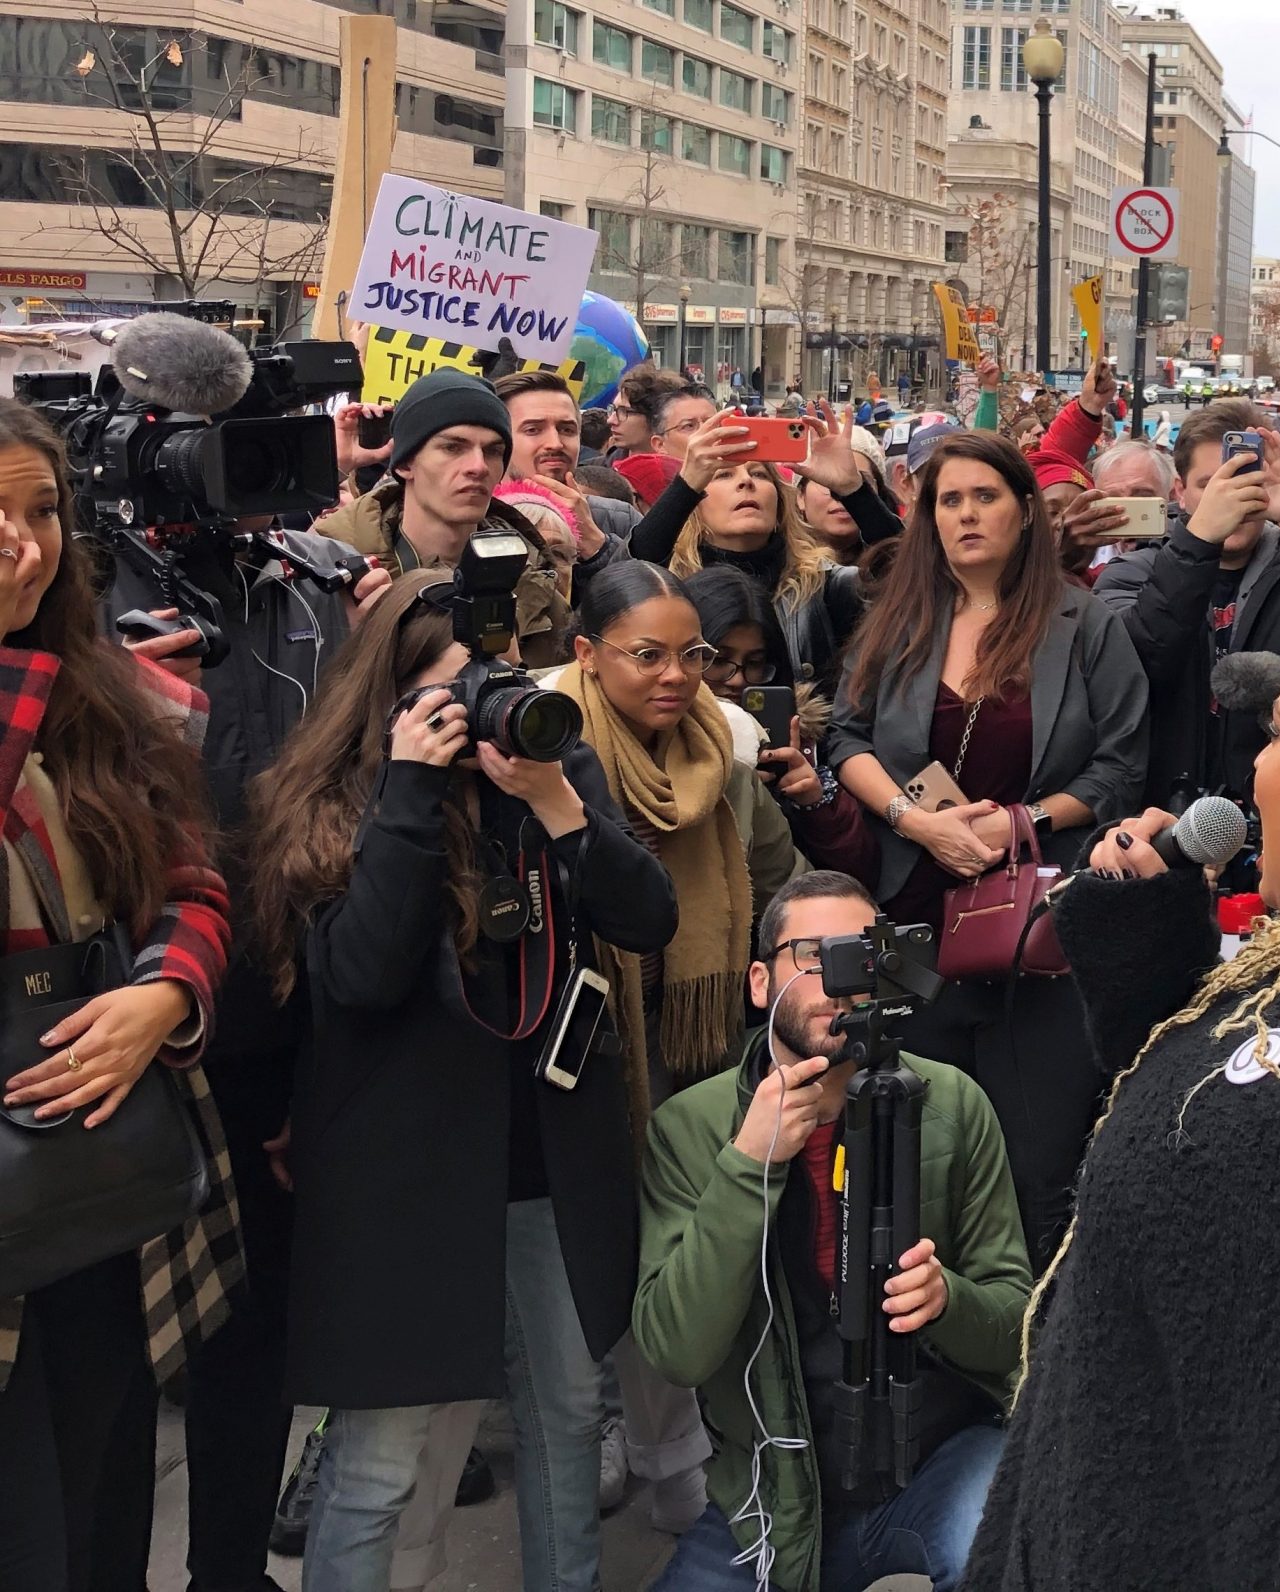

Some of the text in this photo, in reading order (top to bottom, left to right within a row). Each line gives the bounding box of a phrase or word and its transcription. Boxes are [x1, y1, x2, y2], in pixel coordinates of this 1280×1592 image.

[395, 194, 550, 262] CLIMATE
[455, 249, 481, 263] AND
[30, 274, 83, 287] FARGO
[364, 282, 568, 342] JUSTICE NOW
[489, 671, 513, 679] Canon
[491, 902, 520, 917] Canon
[528, 870, 543, 933] Canon
[25, 971, 52, 996] MEC
